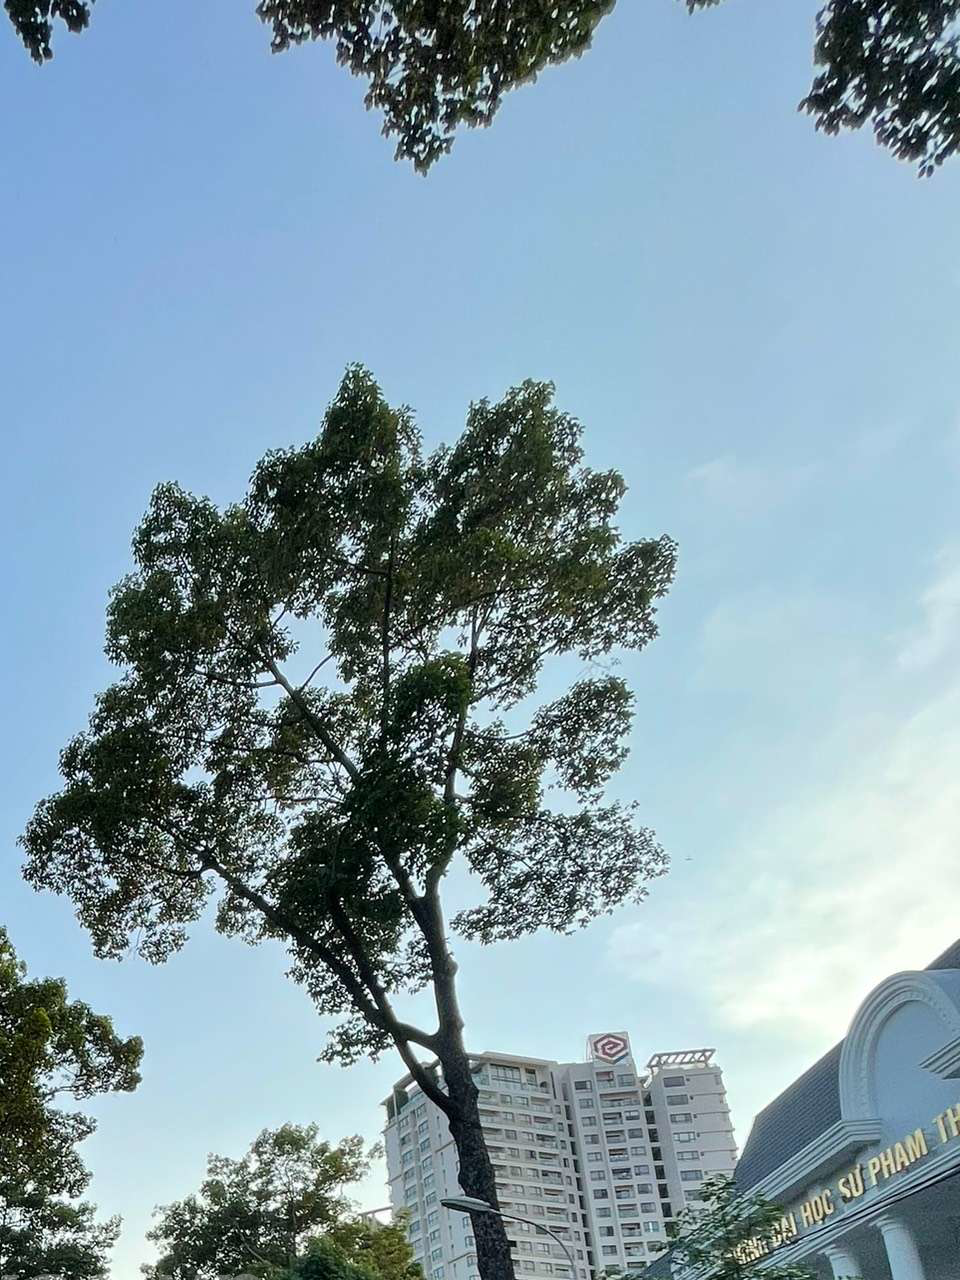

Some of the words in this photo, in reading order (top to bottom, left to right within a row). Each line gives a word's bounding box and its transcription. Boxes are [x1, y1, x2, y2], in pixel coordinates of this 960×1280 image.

[800, 1188, 835, 1228] HỌC
[838, 1163, 865, 1198] SƯ
[868, 1128, 929, 1186] PHẠM
